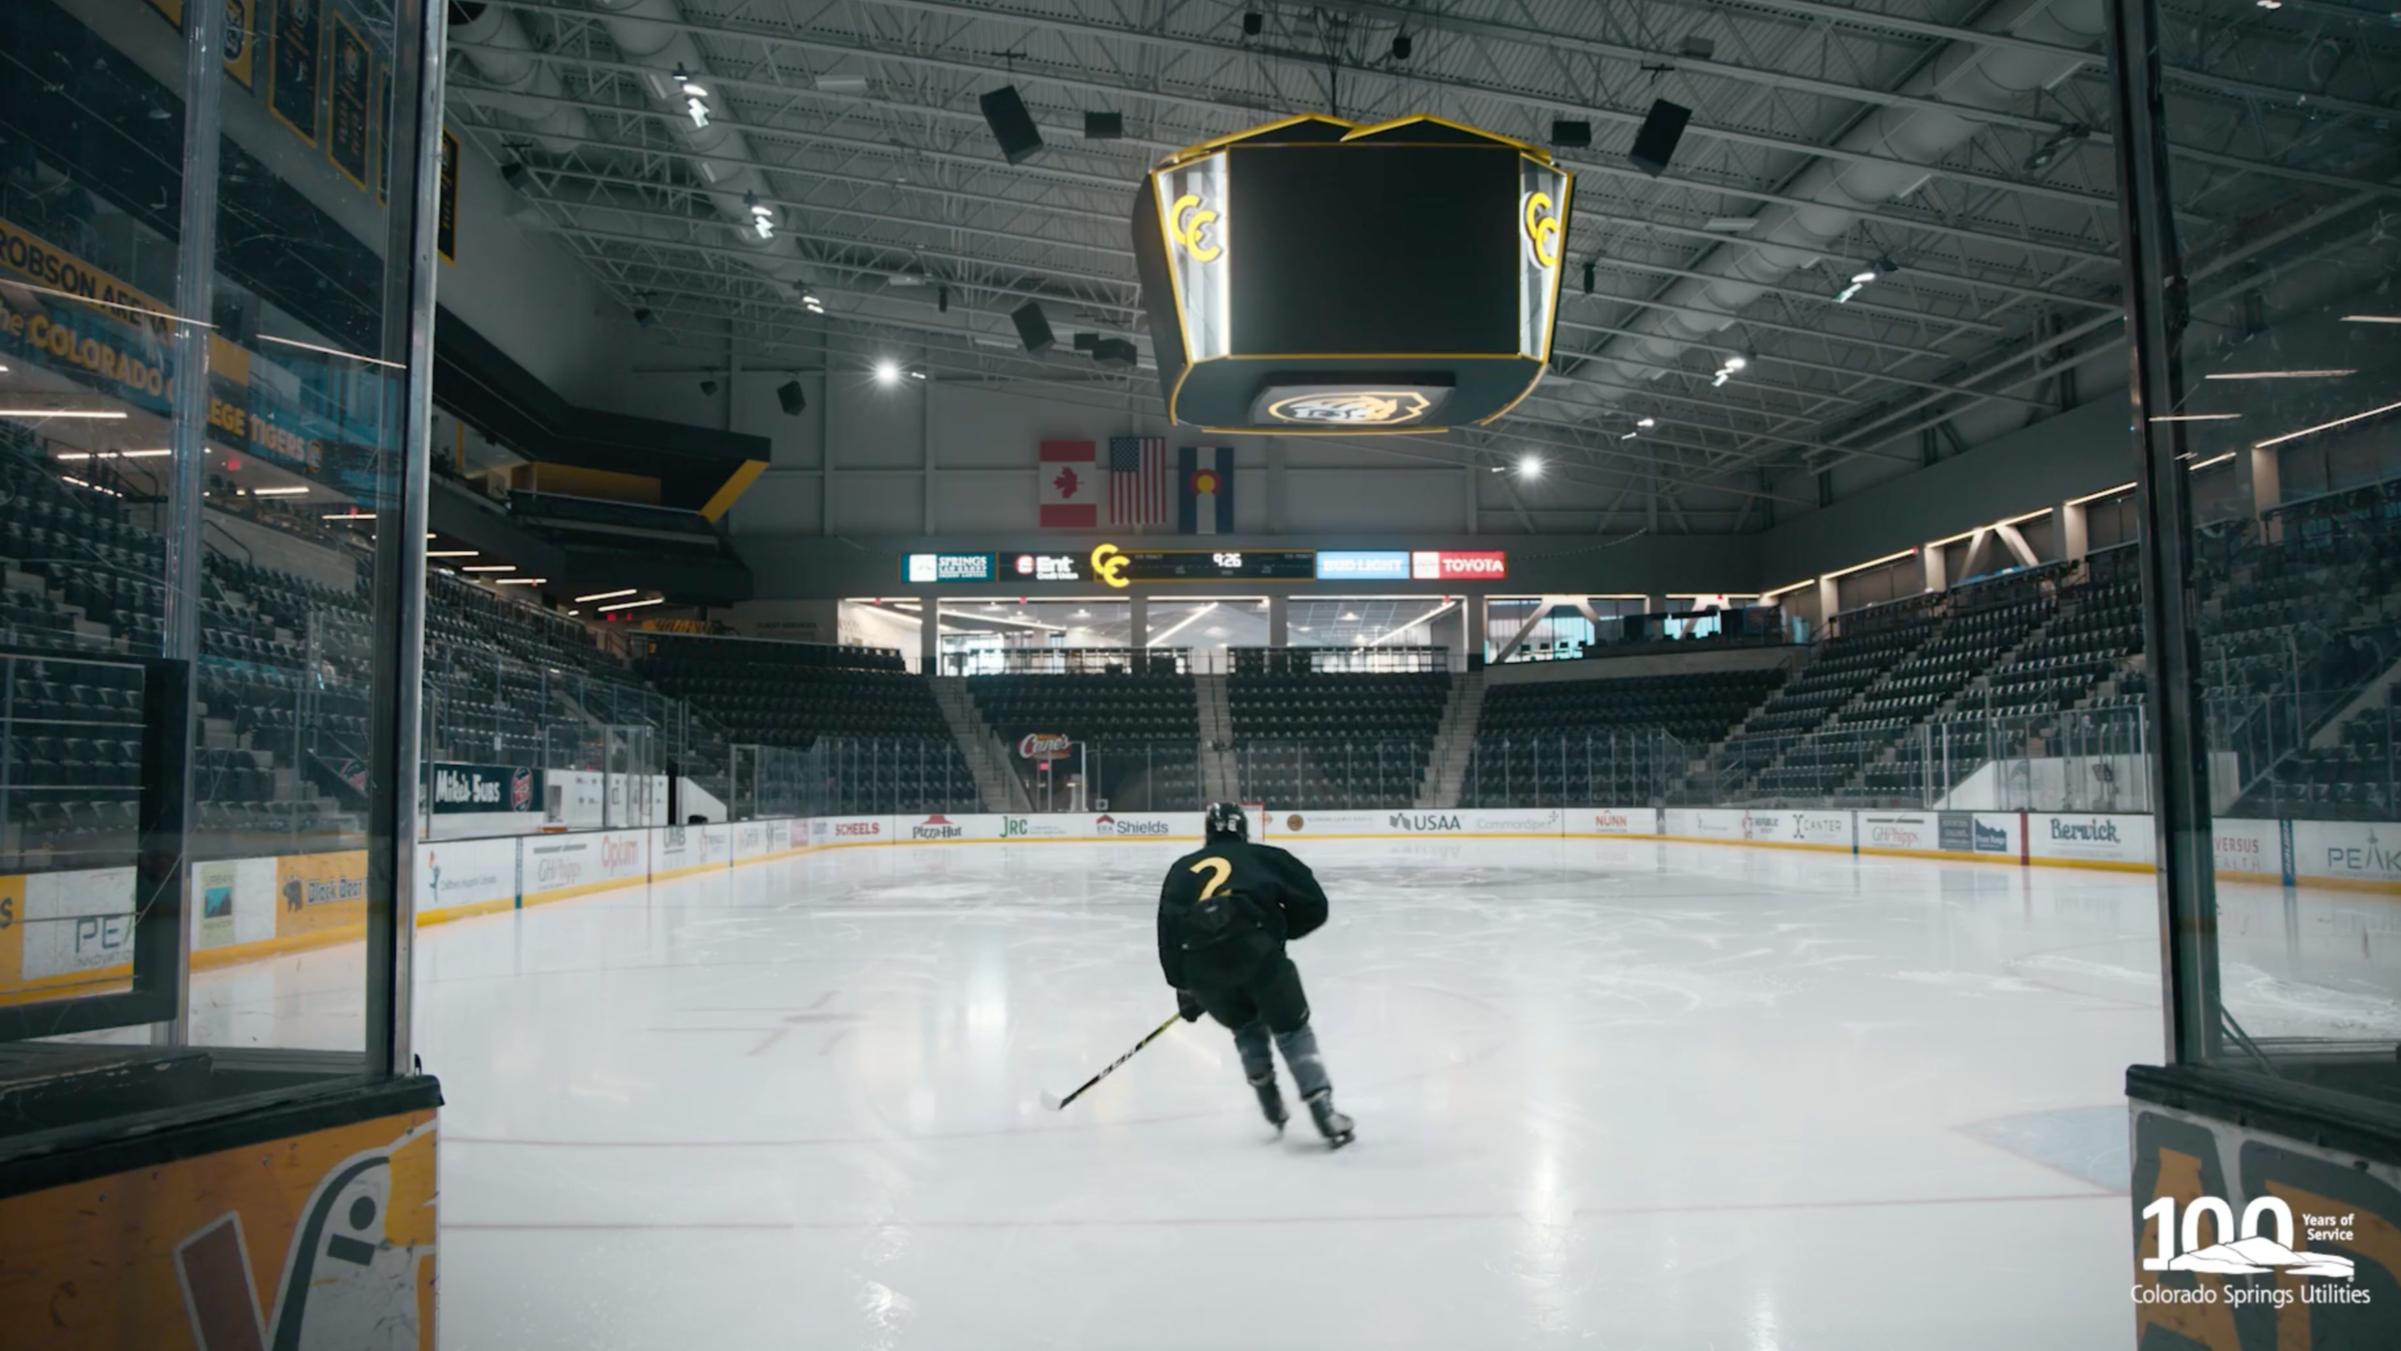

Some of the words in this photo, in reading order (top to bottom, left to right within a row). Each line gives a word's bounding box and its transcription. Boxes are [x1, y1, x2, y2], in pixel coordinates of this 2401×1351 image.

[29, 315, 162, 397] COLORADO
[249, 414, 305, 463] TIGERS
[939, 556, 987, 567] SPRINGS
[1036, 555, 1074, 572] Ent
[1323, 559, 1356, 571] BUD
[1357, 559, 1403, 571] LIGHT
[1442, 559, 1504, 572] TOYOTA
[835, 822, 880, 836] SCHEELS
[999, 816, 1027, 838] JRC
[1117, 821, 1168, 834] Shields
[1414, 815, 1461, 831] USAA
[2050, 818, 2121, 843] Berwick
[912, 826, 941, 839] Pizza
[941, 826, 962, 838] Hut
[1189, 857, 1233, 901] 2
[306, 879, 335, 905] Black
